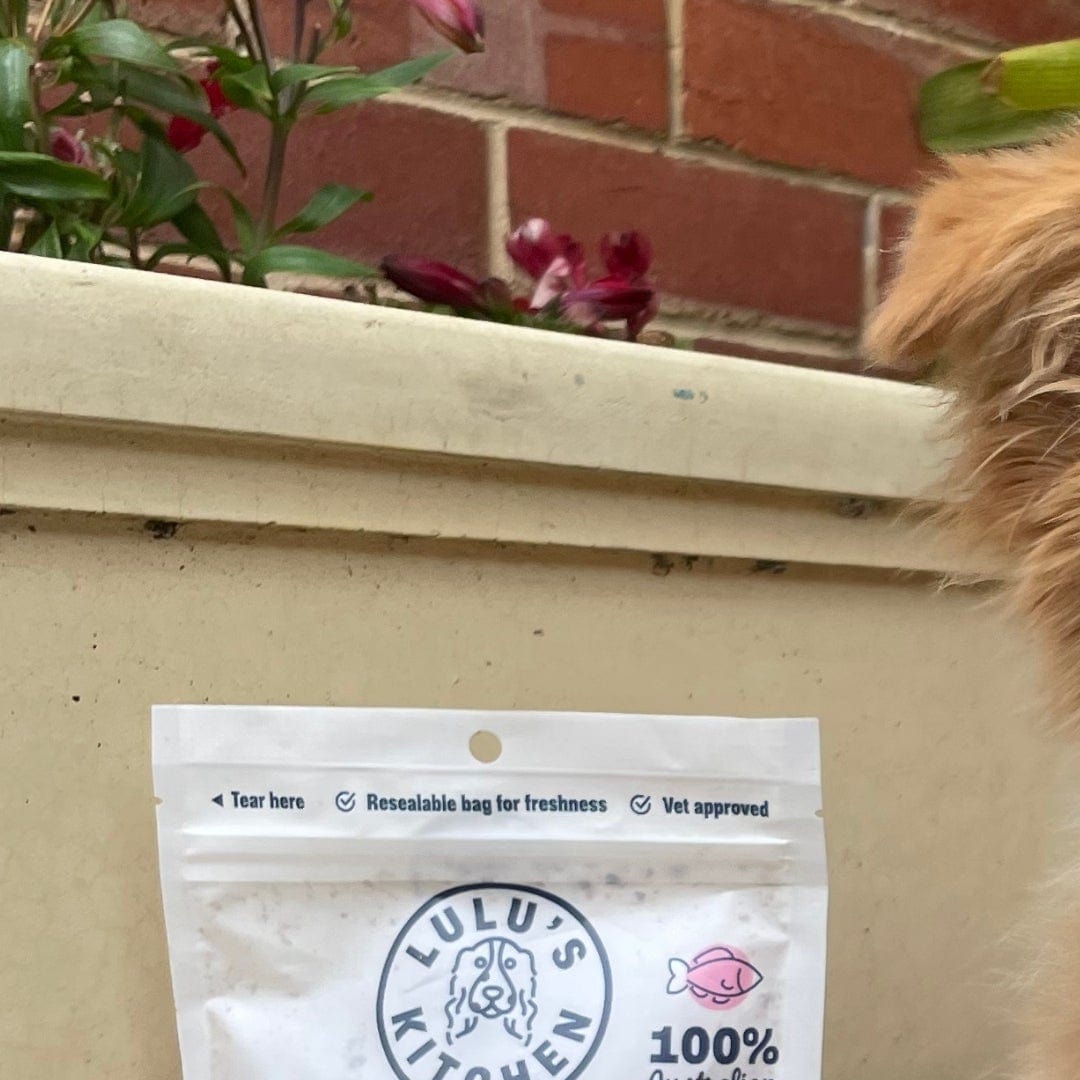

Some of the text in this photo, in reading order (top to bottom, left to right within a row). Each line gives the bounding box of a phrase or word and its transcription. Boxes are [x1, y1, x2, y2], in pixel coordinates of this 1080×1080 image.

[231, 791, 305, 810] Tear here
[367, 794, 607, 816] Resealable bag for freshness
[662, 796, 769, 818] Vet approved
[405, 897, 587, 970] LULU'S
[650, 1025, 780, 1065] 100%
